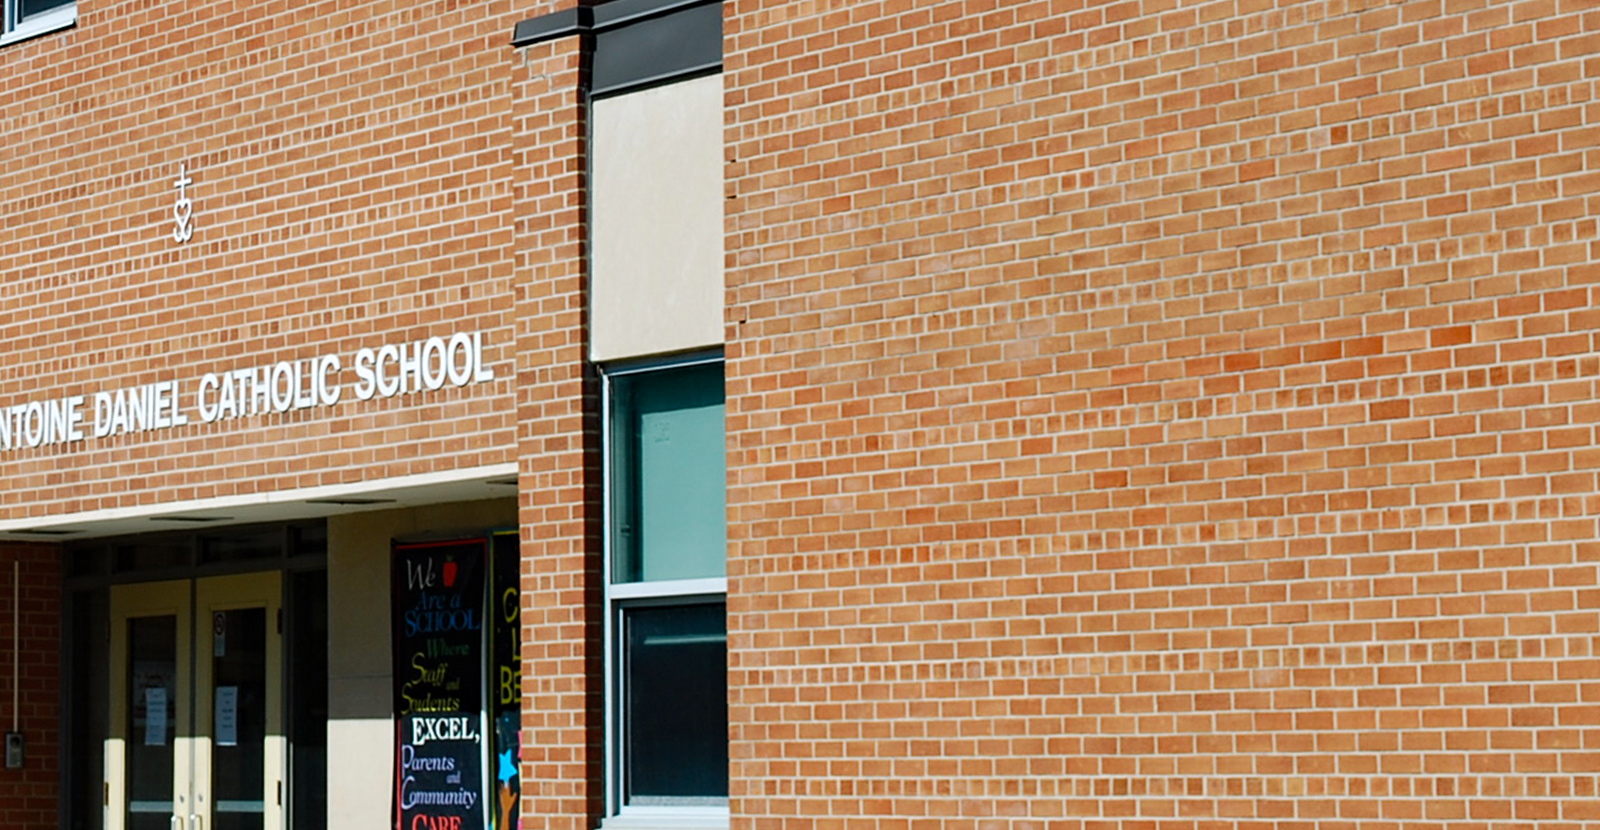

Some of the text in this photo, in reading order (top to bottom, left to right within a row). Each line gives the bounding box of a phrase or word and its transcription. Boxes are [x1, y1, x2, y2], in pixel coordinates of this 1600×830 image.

[95, 380, 188, 438] DANIEL
[198, 354, 342, 422] CATHOLIC
[354, 331, 494, 400] SCHOOL
[406, 557, 436, 590] We
[415, 590, 462, 611] Are a
[404, 608, 481, 638] SCHOOL
[426, 637, 471, 659] Where
[411, 652, 449, 687] Staff
[400, 681, 461, 715] Students
[412, 717, 481, 746] EXCEL,
[401, 744, 455, 779] Parents
[401, 776, 477, 810] Community
